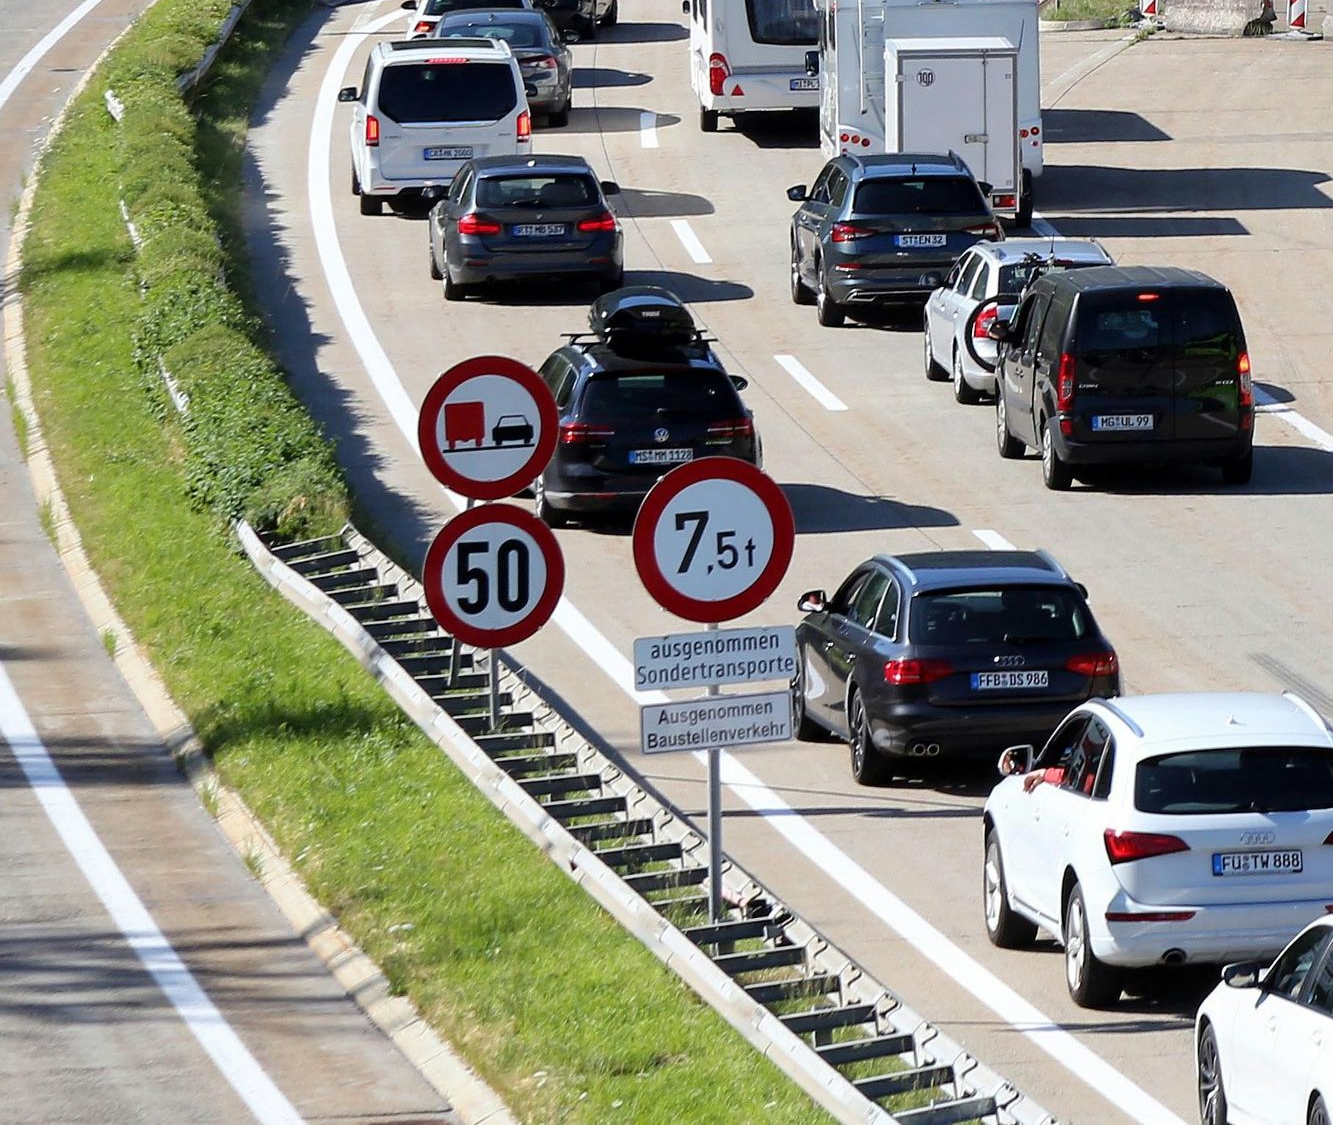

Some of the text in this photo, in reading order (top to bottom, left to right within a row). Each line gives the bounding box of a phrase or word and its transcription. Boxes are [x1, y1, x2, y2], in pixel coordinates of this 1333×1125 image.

[1136, 415, 1149, 426] 99
[456, 539, 530, 615] 50
[651, 634, 779, 661] ausgenommen
[637, 655, 794, 686] Sondertransporte
[979, 672, 1047, 687] FFB DS 986
[658, 702, 773, 725] Ausgenommen
[648, 721, 786, 749] Baustellenverkehr
[1251, 855, 1270, 869] TW
[1273, 853, 1300, 868] 888
